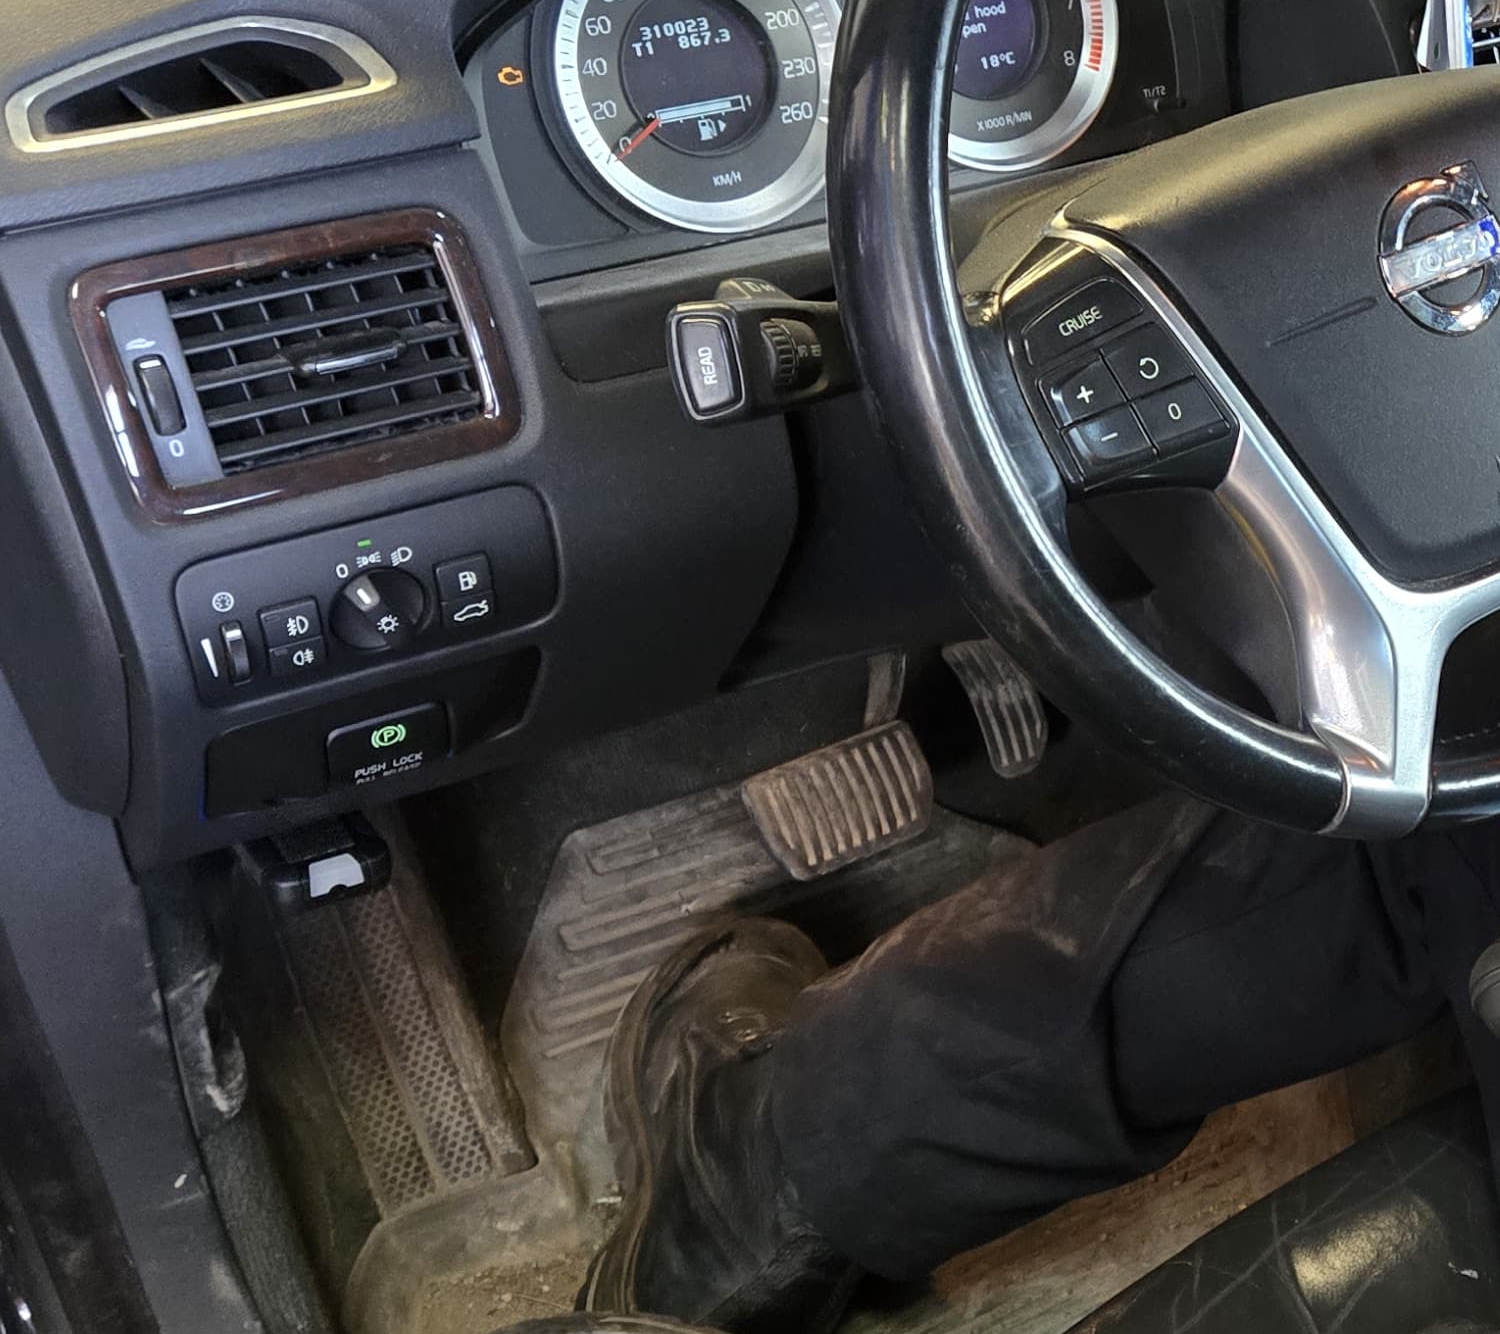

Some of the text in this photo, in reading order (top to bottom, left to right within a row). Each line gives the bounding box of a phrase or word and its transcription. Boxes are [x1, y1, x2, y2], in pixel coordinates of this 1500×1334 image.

[766, 9, 799, 30] 200
[974, 1, 1006, 20] hood
[585, 16, 612, 36] 60
[640, 17, 709, 41] 310023
[962, 21, 987, 39] pen
[632, 29, 731, 57] T1 867.3
[582, 57, 608, 77] 40
[782, 57, 817, 79] 230
[980, 51, 1016, 70] 18°C
[1063, 50, 1076, 67] 8
[591, 99, 617, 121] 20
[780, 101, 814, 124] 260
[1006, 110, 1033, 127] R/MIN
[712, 170, 742, 188] KM/H
[1058, 305, 1103, 338] CRUISE
[697, 346, 718, 386] READ
[354, 751, 423, 779] PUSH LOCK
